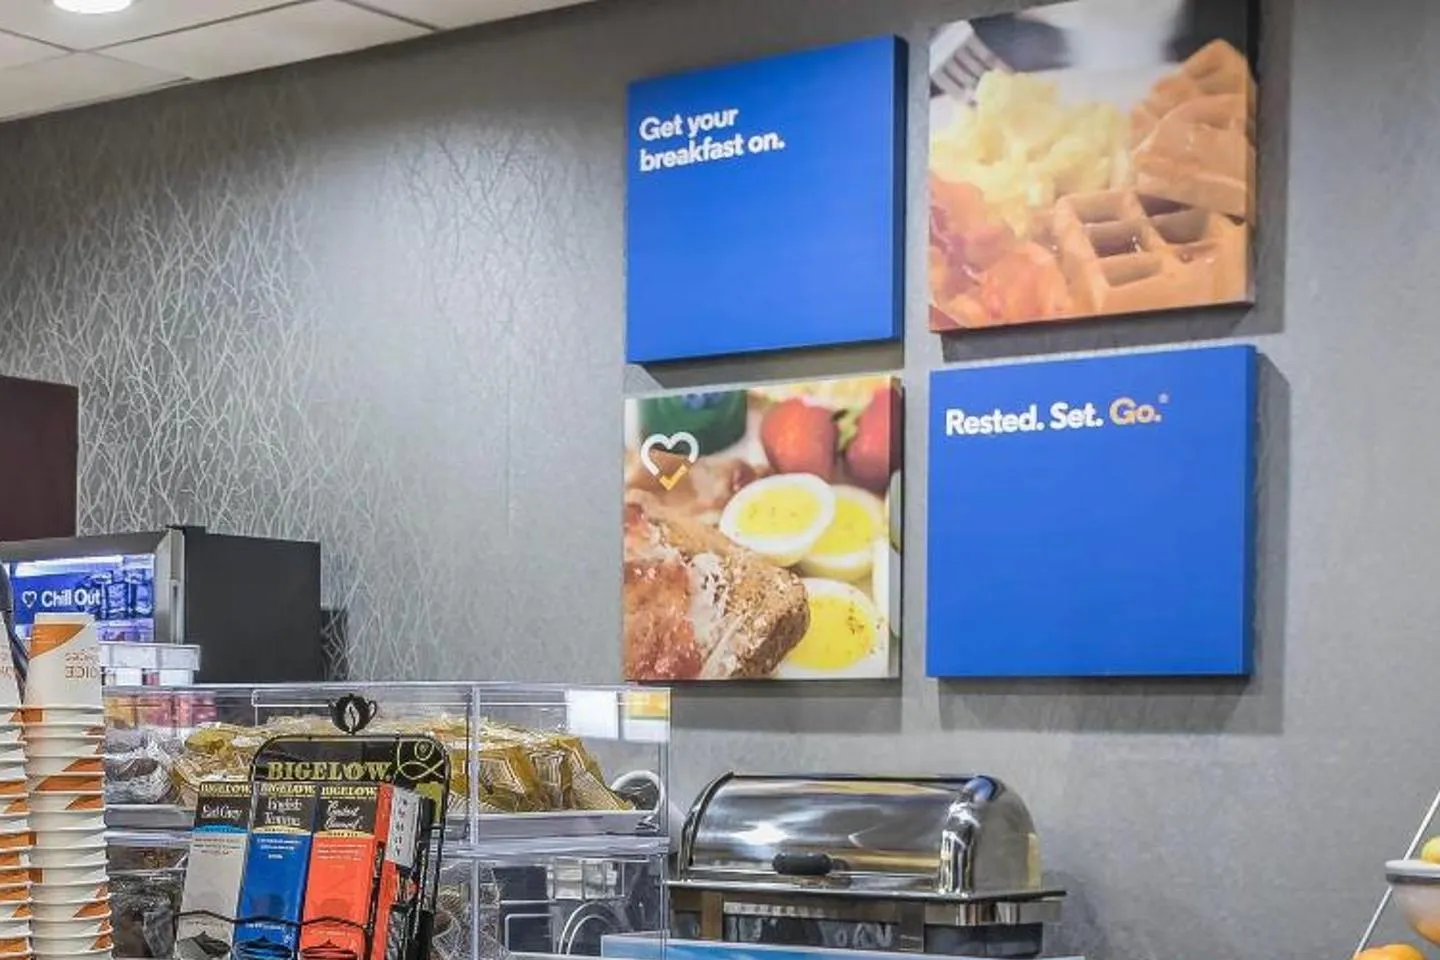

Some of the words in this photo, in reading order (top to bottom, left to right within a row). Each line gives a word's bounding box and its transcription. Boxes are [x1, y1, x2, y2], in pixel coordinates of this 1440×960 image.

[639, 114, 684, 141] Get
[687, 108, 739, 138] your
[639, 133, 745, 172] breakfast
[748, 132, 786, 154] on.
[945, 404, 1045, 436] Rested.
[1050, 402, 1104, 430] Set.
[41, 590, 72, 608] Chill
[74, 588, 101, 606] Out
